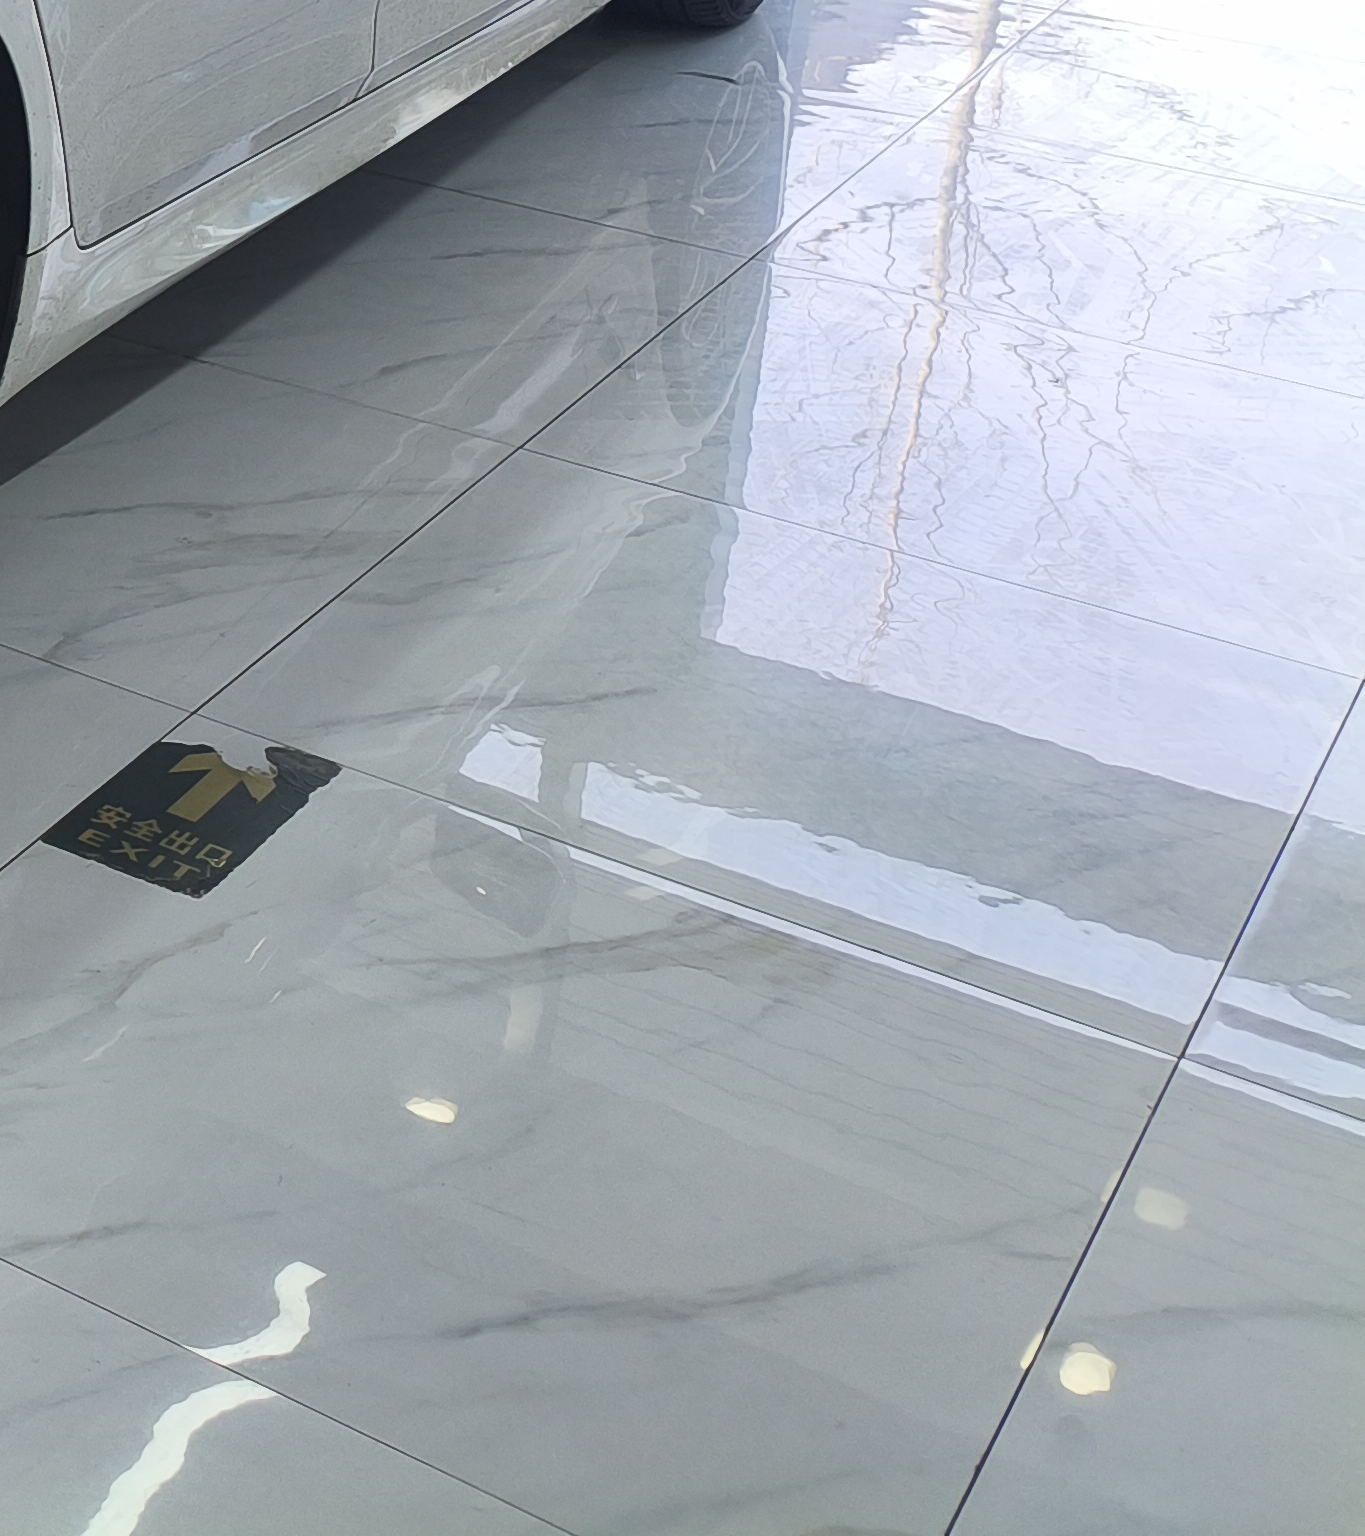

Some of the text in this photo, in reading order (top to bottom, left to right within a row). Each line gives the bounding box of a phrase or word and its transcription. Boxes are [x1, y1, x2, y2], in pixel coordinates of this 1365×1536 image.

[77, 828, 201, 880] EXIT
[90, 804, 234, 868] 安全出口
